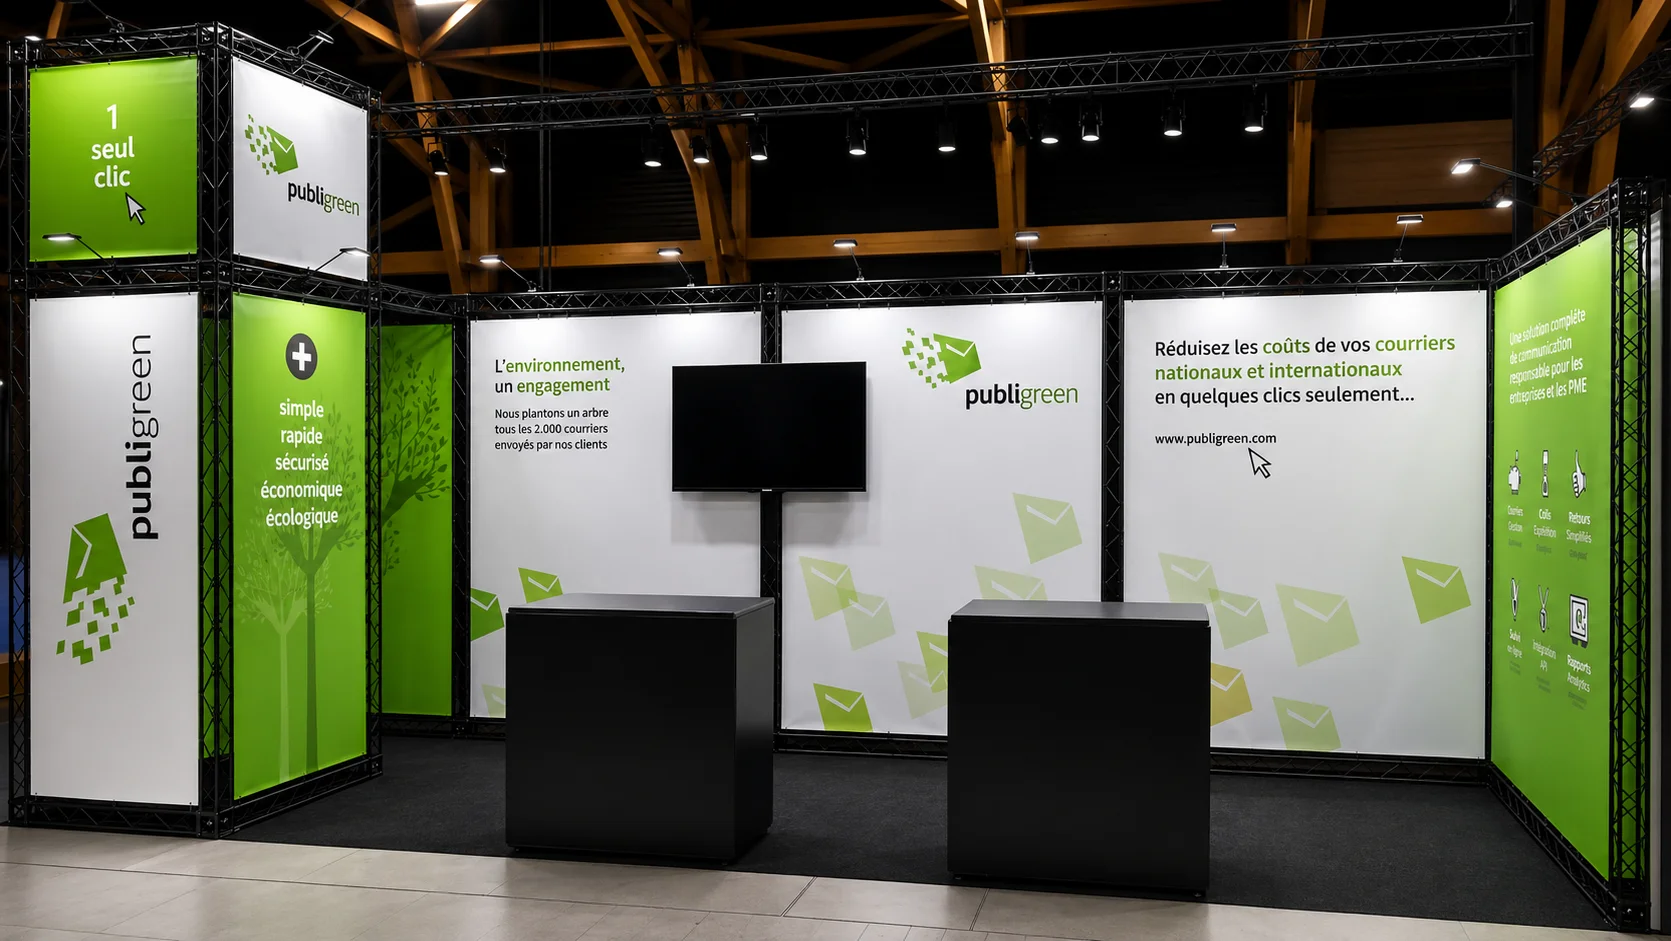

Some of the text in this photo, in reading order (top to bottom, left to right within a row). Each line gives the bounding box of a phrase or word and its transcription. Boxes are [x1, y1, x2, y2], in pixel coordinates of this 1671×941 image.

[106, 103, 117, 130] 1
[91, 135, 135, 160] seul
[94, 164, 131, 188] clic
[288, 182, 360, 216] publigreen
[1510, 332, 1521, 345] Une
[1523, 323, 1550, 340] solution
[1155, 335, 1455, 356] Réduisez les coûts de vos courriers
[1510, 351, 1517, 364] de
[1155, 361, 1403, 380] nationaux et internationaux
[1510, 356, 1583, 386] responsable pour les
[495, 378, 610, 396] un engagement
[965, 383, 1079, 410] publigreen
[1155, 392, 1175, 404] en
[1180, 388, 1258, 408] quelques
[1263, 387, 1301, 403] clics
[1510, 377, 1587, 405] entreprises et les PME
[280, 398, 324, 421] simple
[495, 407, 609, 420] Nous plantons un arbre
[124, 334, 159, 540] publigreen
[281, 426, 323, 448] rapide
[495, 424, 608, 434] tous les 2.000 courriers
[1155, 432, 1277, 446] www.publigreen.com
[495, 439, 608, 452] envoyés par nos clients
[275, 452, 329, 471] sécurisé
[260, 480, 343, 502] économique
[266, 507, 338, 530] écologique
